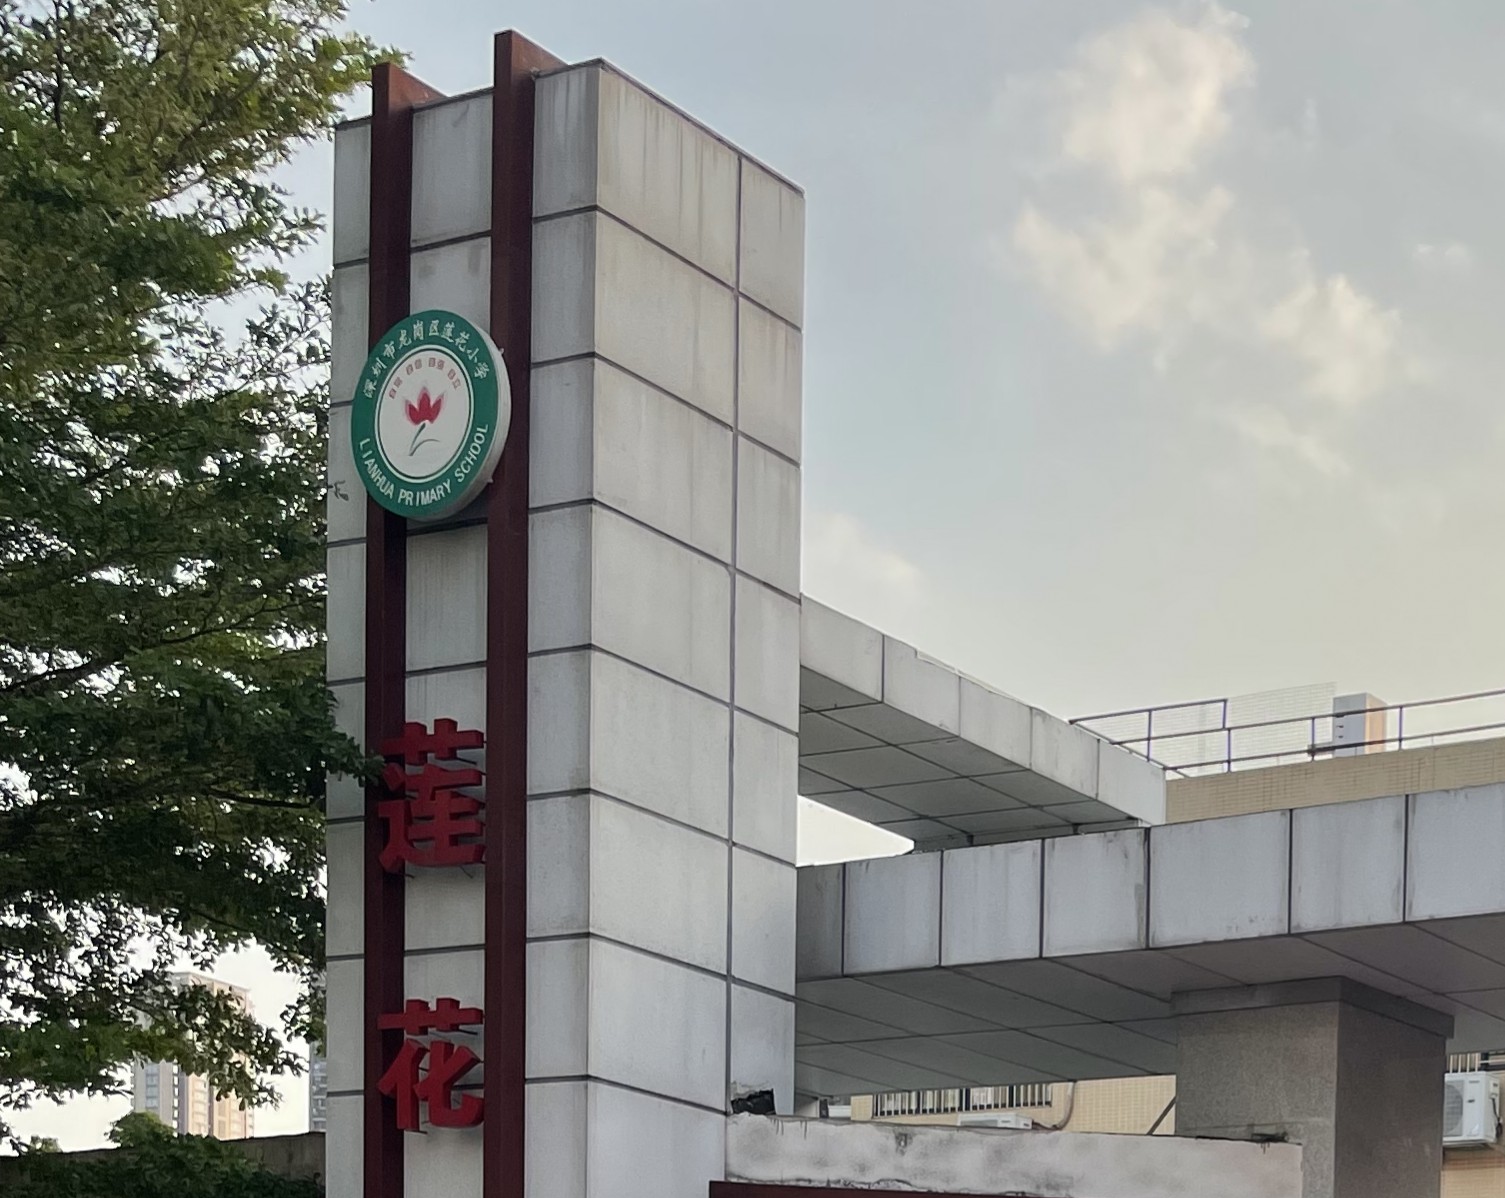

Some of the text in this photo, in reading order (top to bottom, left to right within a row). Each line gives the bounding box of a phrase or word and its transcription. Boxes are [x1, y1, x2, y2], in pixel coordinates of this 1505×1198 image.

[363, 319, 490, 398] 深圳市龙岗区莲花小学
[359, 423, 488, 507] LIANHUA PRIMARY SCHOOL
